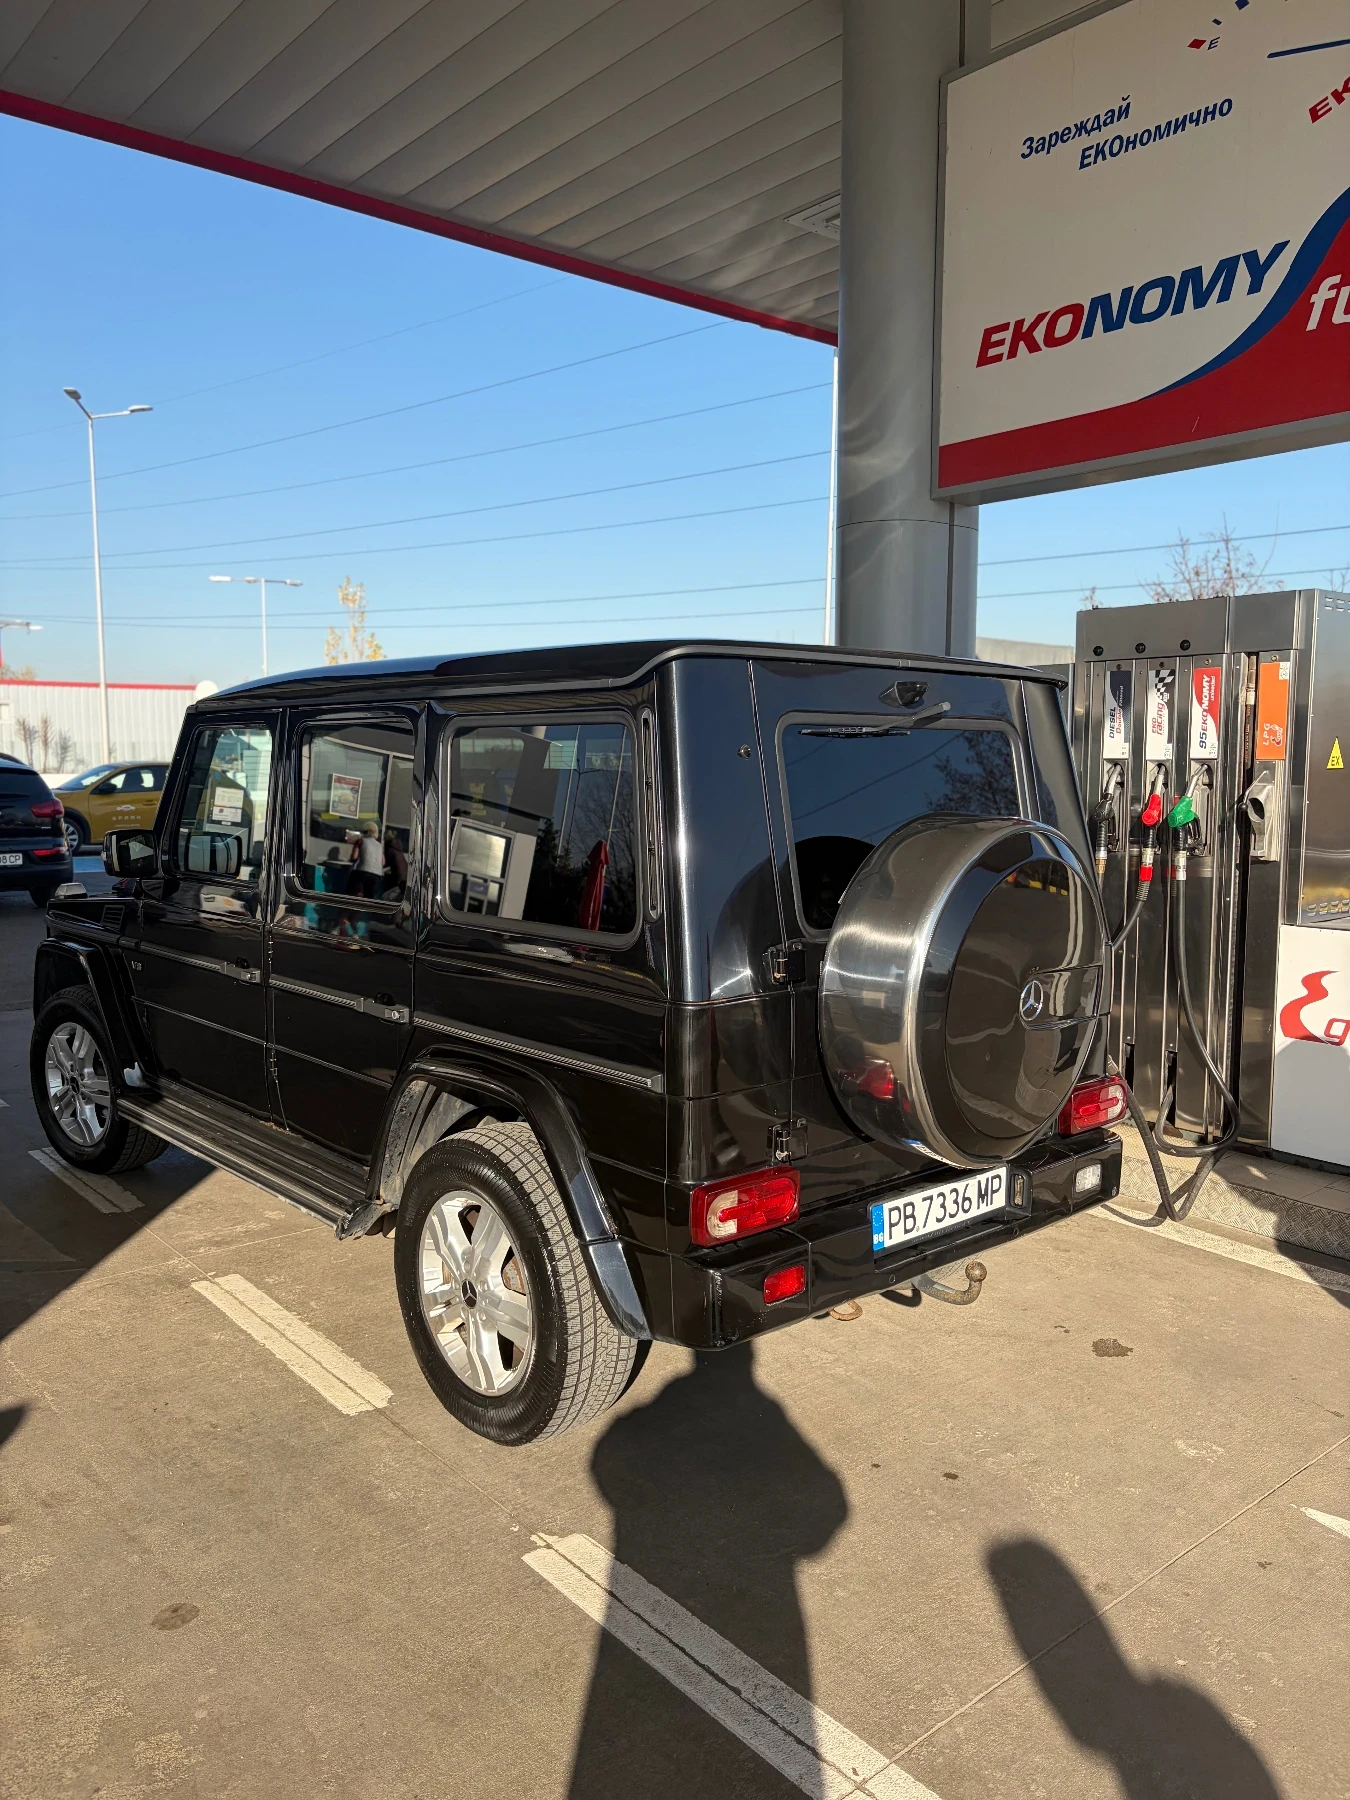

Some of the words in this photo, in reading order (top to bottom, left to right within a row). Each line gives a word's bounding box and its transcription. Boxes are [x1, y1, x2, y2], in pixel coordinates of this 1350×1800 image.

[1207, 36, 1221, 51] E
[1020, 95, 1132, 160] Зареждай
[1078, 98, 1233, 170] ЕКОномично
[975, 240, 1291, 368] EKONOMY
[1156, 702, 1166, 736] racing
[1263, 722, 1271, 746] LPG
[1331, 756, 1340, 767] EX
[873, 1232, 884, 1245] BG
